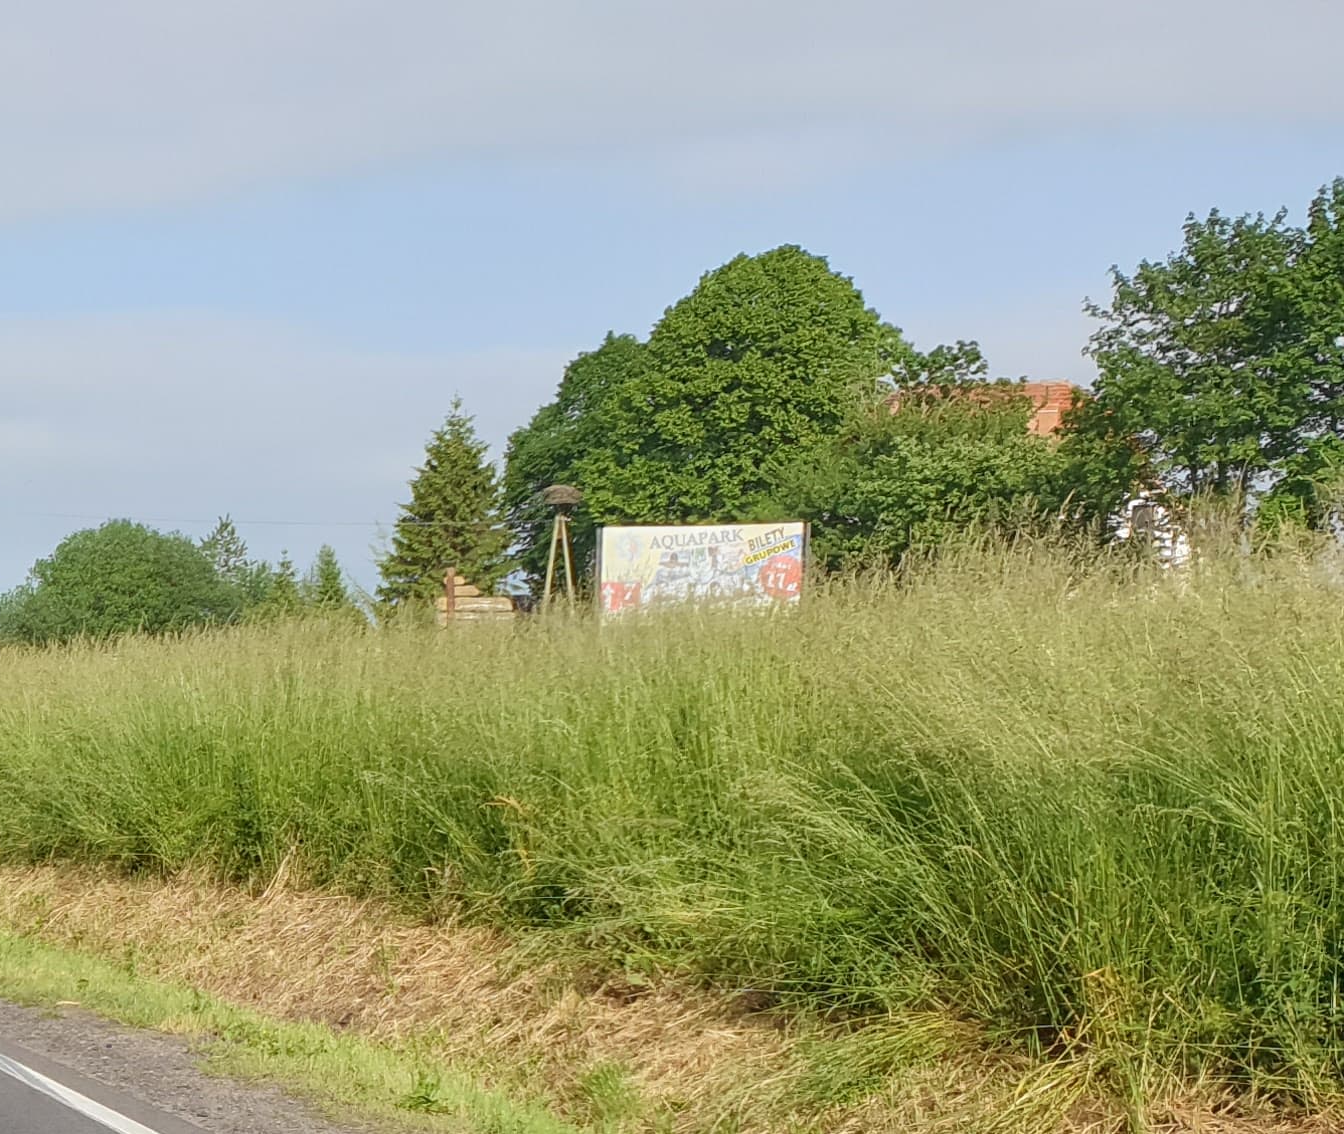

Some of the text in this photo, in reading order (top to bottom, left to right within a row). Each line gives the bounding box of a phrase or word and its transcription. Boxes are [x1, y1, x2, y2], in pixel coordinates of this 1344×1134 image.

[649, 528, 744, 551] AQUAPARK
[748, 527, 786, 552] BILETY
[744, 540, 796, 565] GRUPOWE
